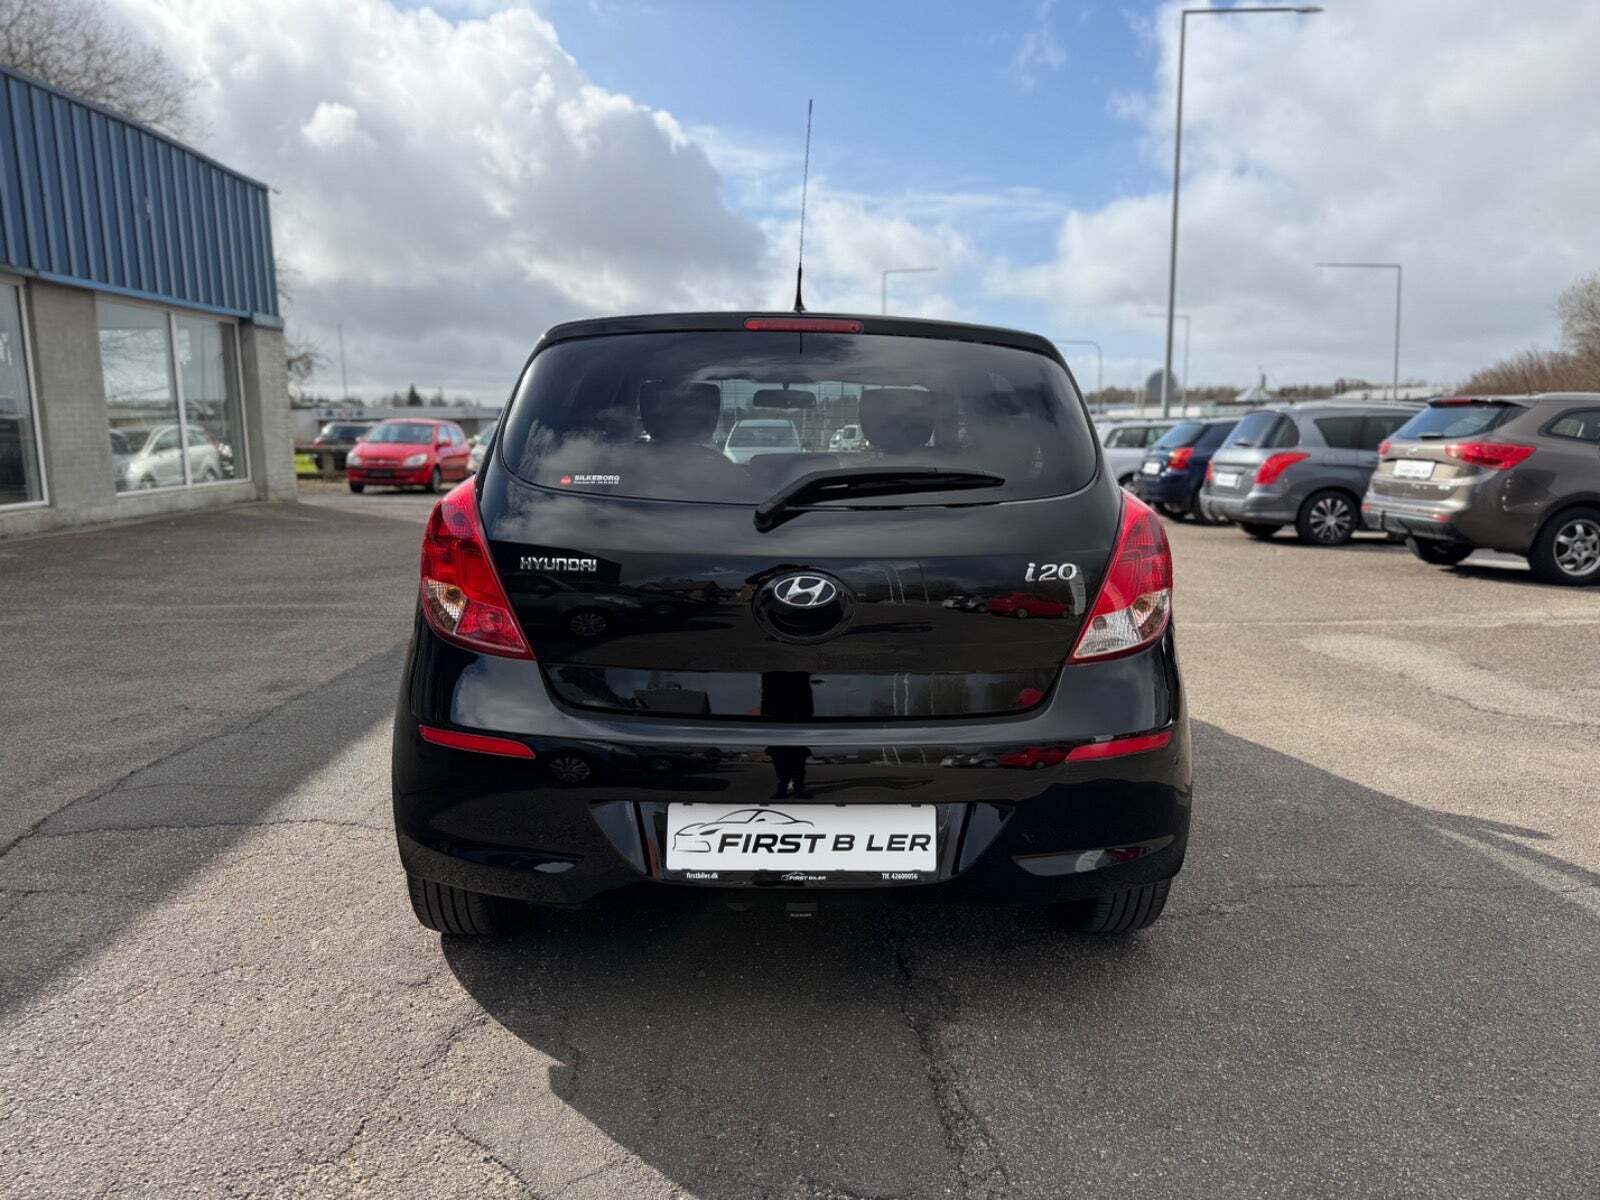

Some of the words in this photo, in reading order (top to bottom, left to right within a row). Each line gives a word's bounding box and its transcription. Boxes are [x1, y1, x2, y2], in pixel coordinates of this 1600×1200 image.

[520, 556, 597, 571] HYUNDAI
[1025, 562, 1077, 582] i20
[717, 833, 826, 853] FIRST
